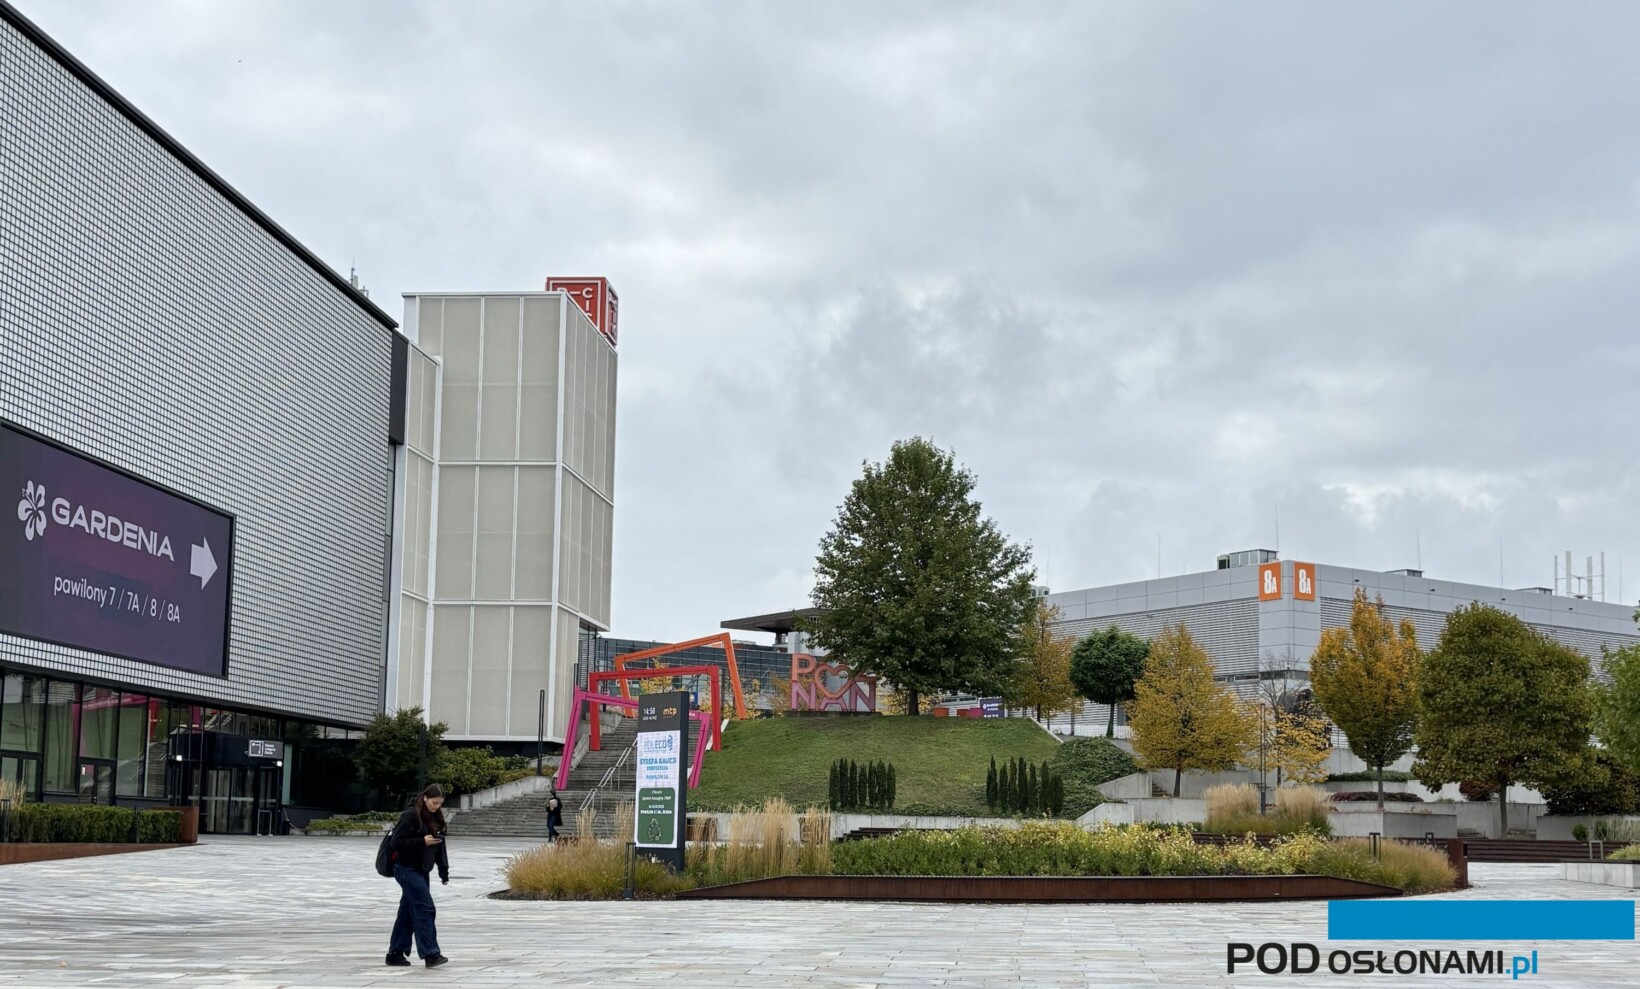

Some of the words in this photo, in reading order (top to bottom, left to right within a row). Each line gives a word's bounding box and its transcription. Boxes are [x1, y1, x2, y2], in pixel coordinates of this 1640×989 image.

[51, 497, 175, 562] GARDENIA
[1264, 570, 1277, 594] 8A
[1299, 569, 1311, 594] 8A
[54, 575, 107, 608] pawilony
[109, 586, 116, 606] 7
[126, 591, 140, 613] 7A
[150, 598, 157, 617] 8
[167, 603, 180, 623] 8A
[643, 707, 656, 716] 14:58
[662, 707, 678, 717] mtp
